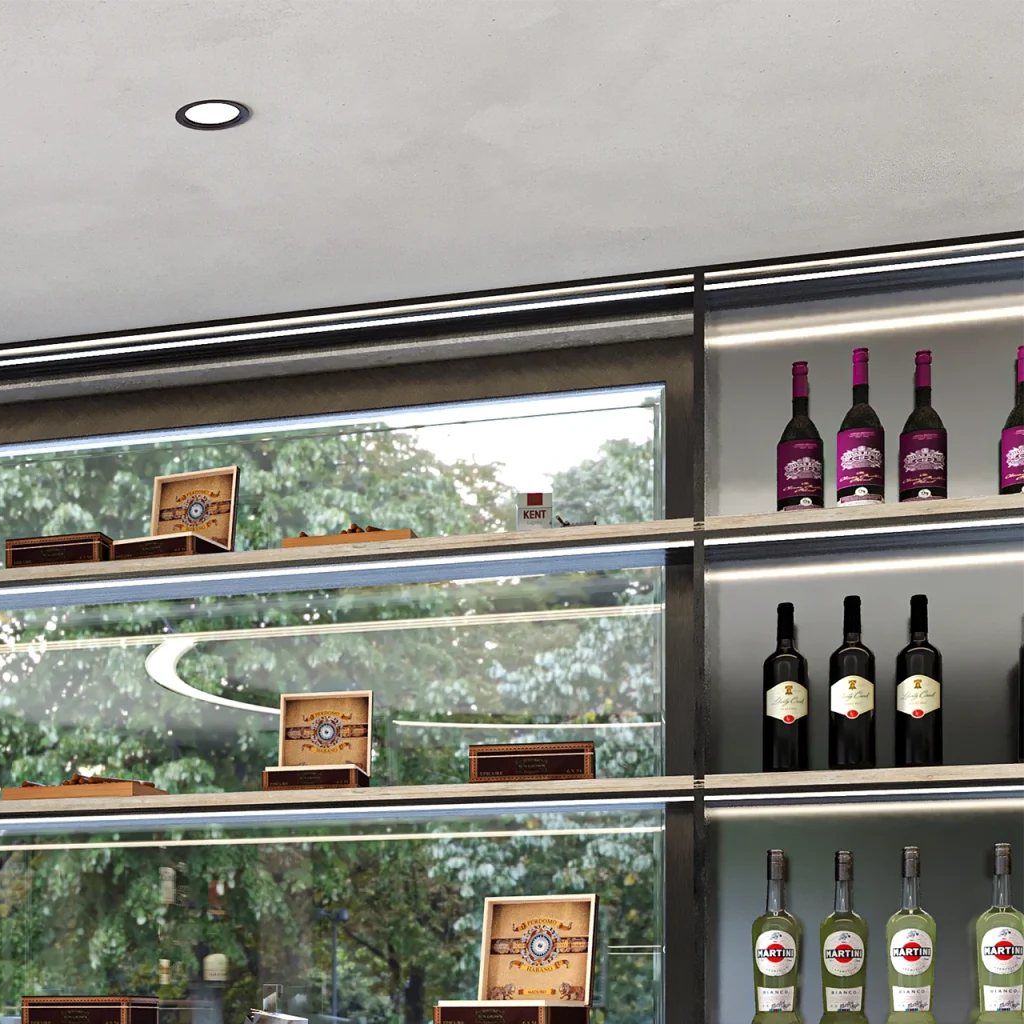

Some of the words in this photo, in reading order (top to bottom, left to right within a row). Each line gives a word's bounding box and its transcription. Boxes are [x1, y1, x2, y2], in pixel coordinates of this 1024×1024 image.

[523, 510, 546, 519] KENT
[758, 948, 794, 958] MARTINI
[826, 950, 862, 958] MARTINI
[893, 948, 931, 957] MARTINI
[984, 946, 1023, 955] MARTINI
